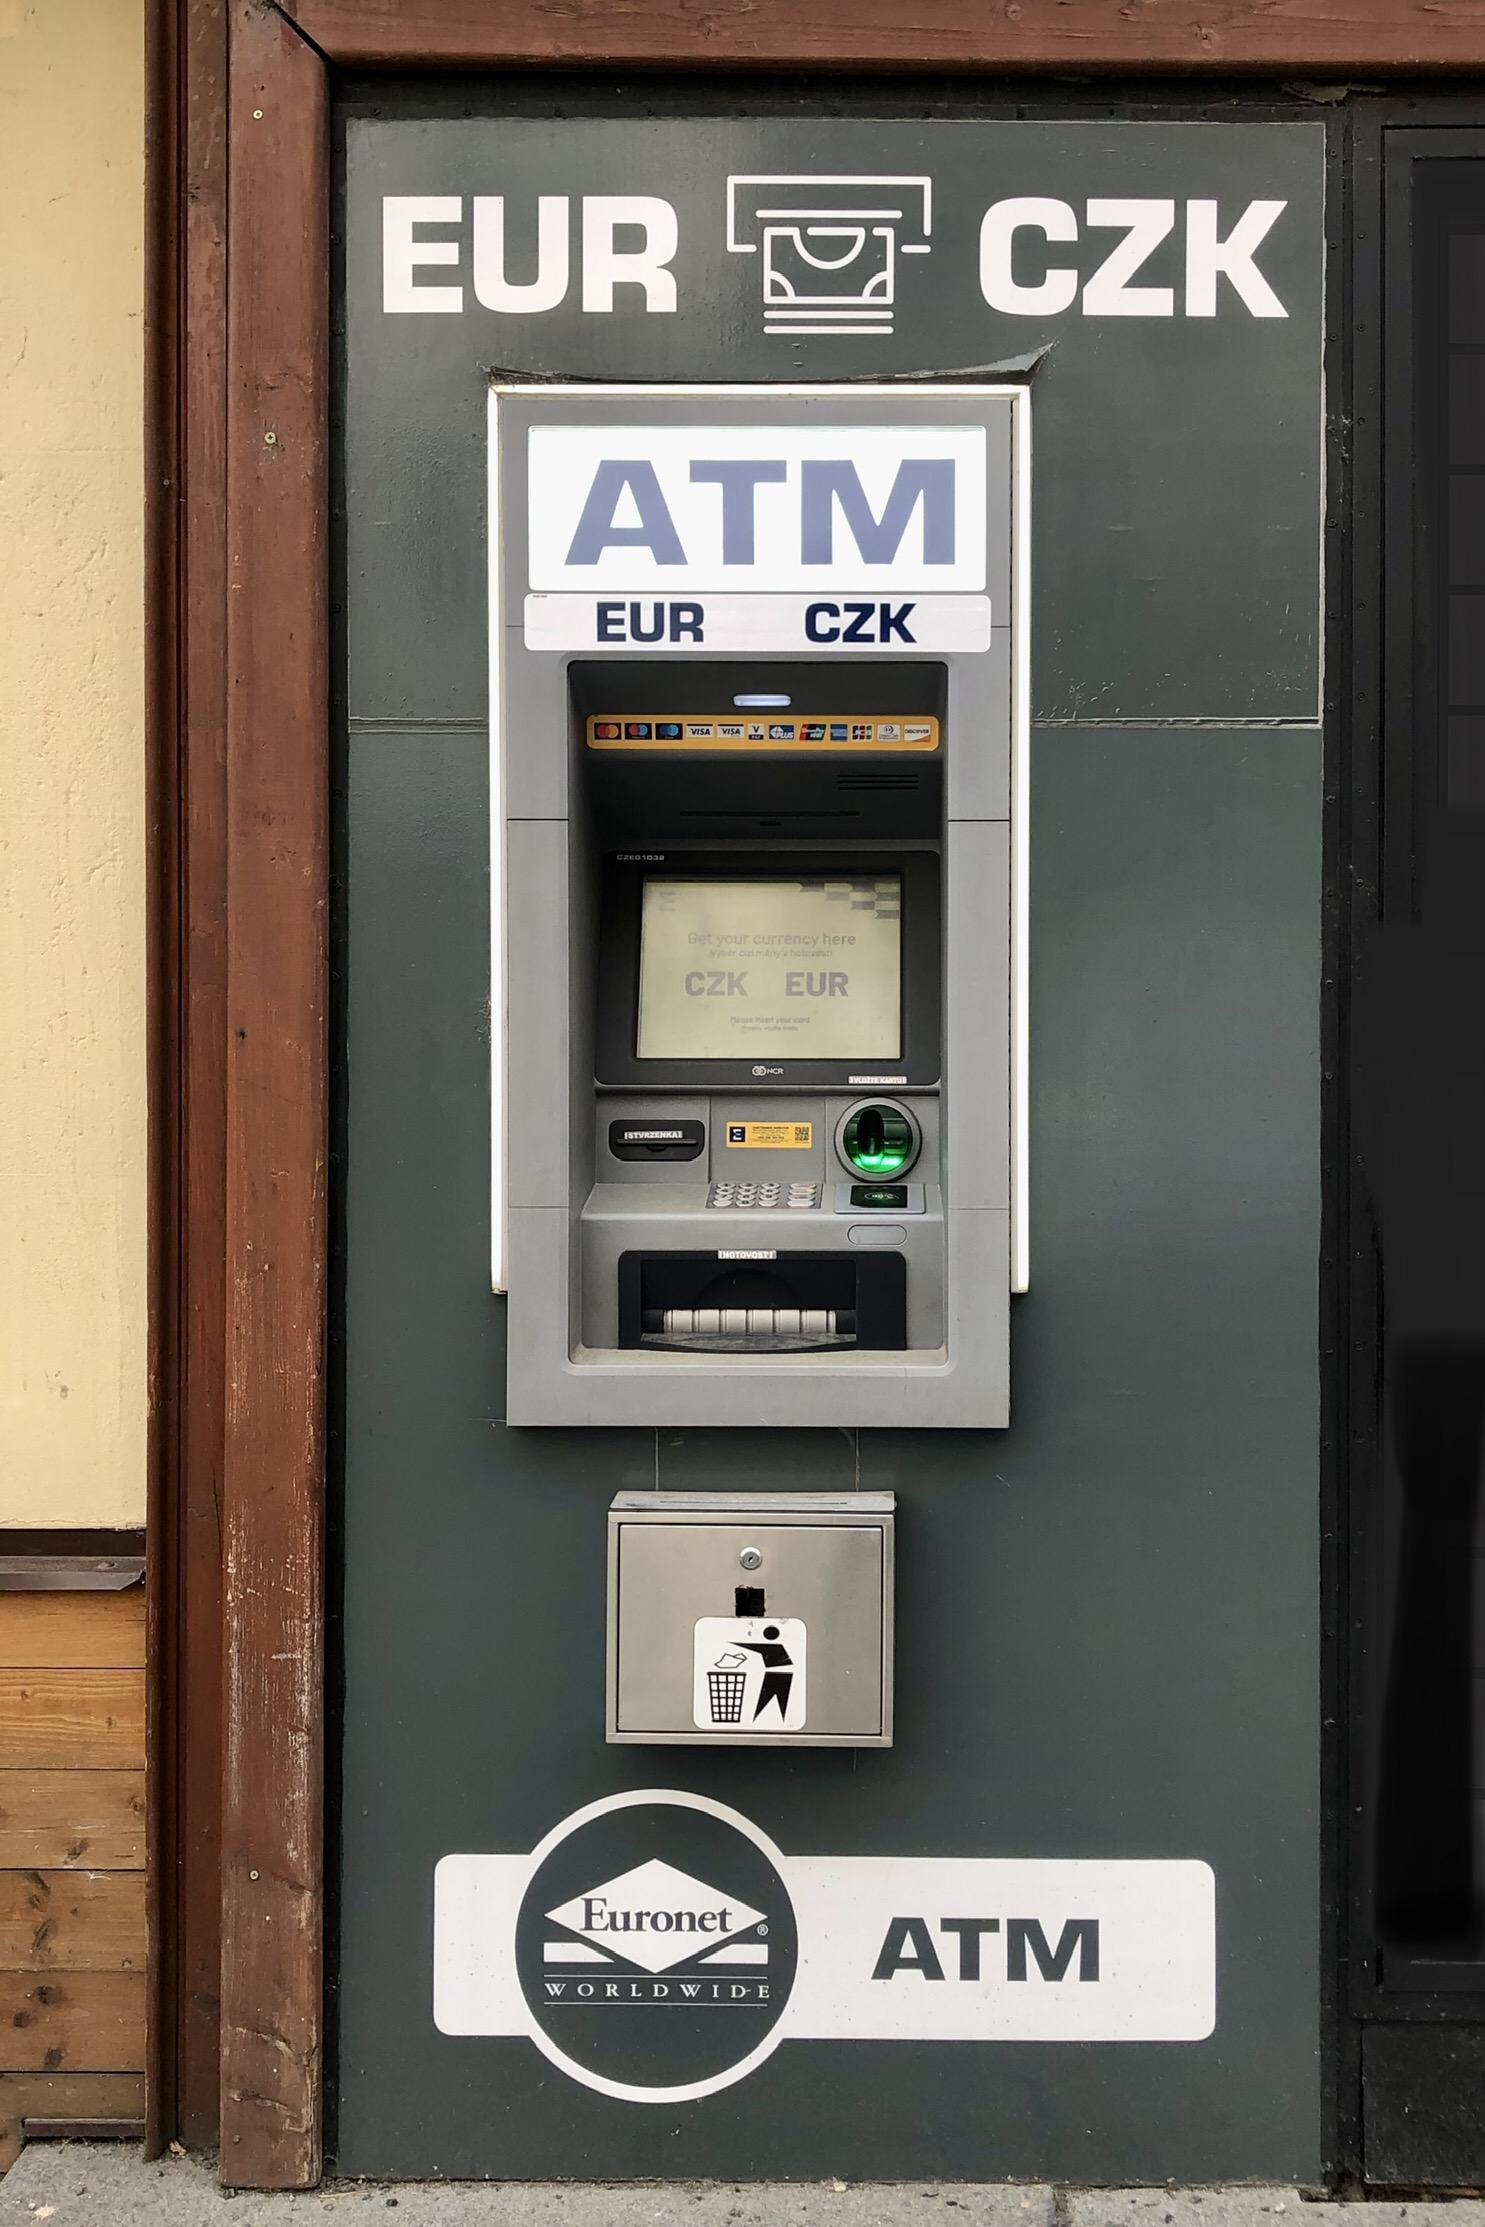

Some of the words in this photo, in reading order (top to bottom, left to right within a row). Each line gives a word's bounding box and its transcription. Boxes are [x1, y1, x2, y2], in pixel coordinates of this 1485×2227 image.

[382, 195, 679, 314] EUR
[979, 196, 1290, 319] CZK
[564, 459, 956, 566] ATM
[596, 601, 704, 643] EUR
[805, 602, 917, 644] CZK
[690, 728, 711, 736] VISA
[721, 728, 741, 736] VISA
[751, 726, 760, 734] V
[776, 731, 794, 739] PLUS
[687, 932, 713, 945] Get
[716, 934, 749, 948] your
[753, 933, 819, 948] currency
[822, 932, 857, 946] here
[684, 971, 748, 997] CZK
[785, 971, 849, 997] EUR
[579, 1897, 733, 1933] Euronet
[870, 1916, 1100, 1982] ATM
[544, 1982, 770, 1999] WORLDWIDE
